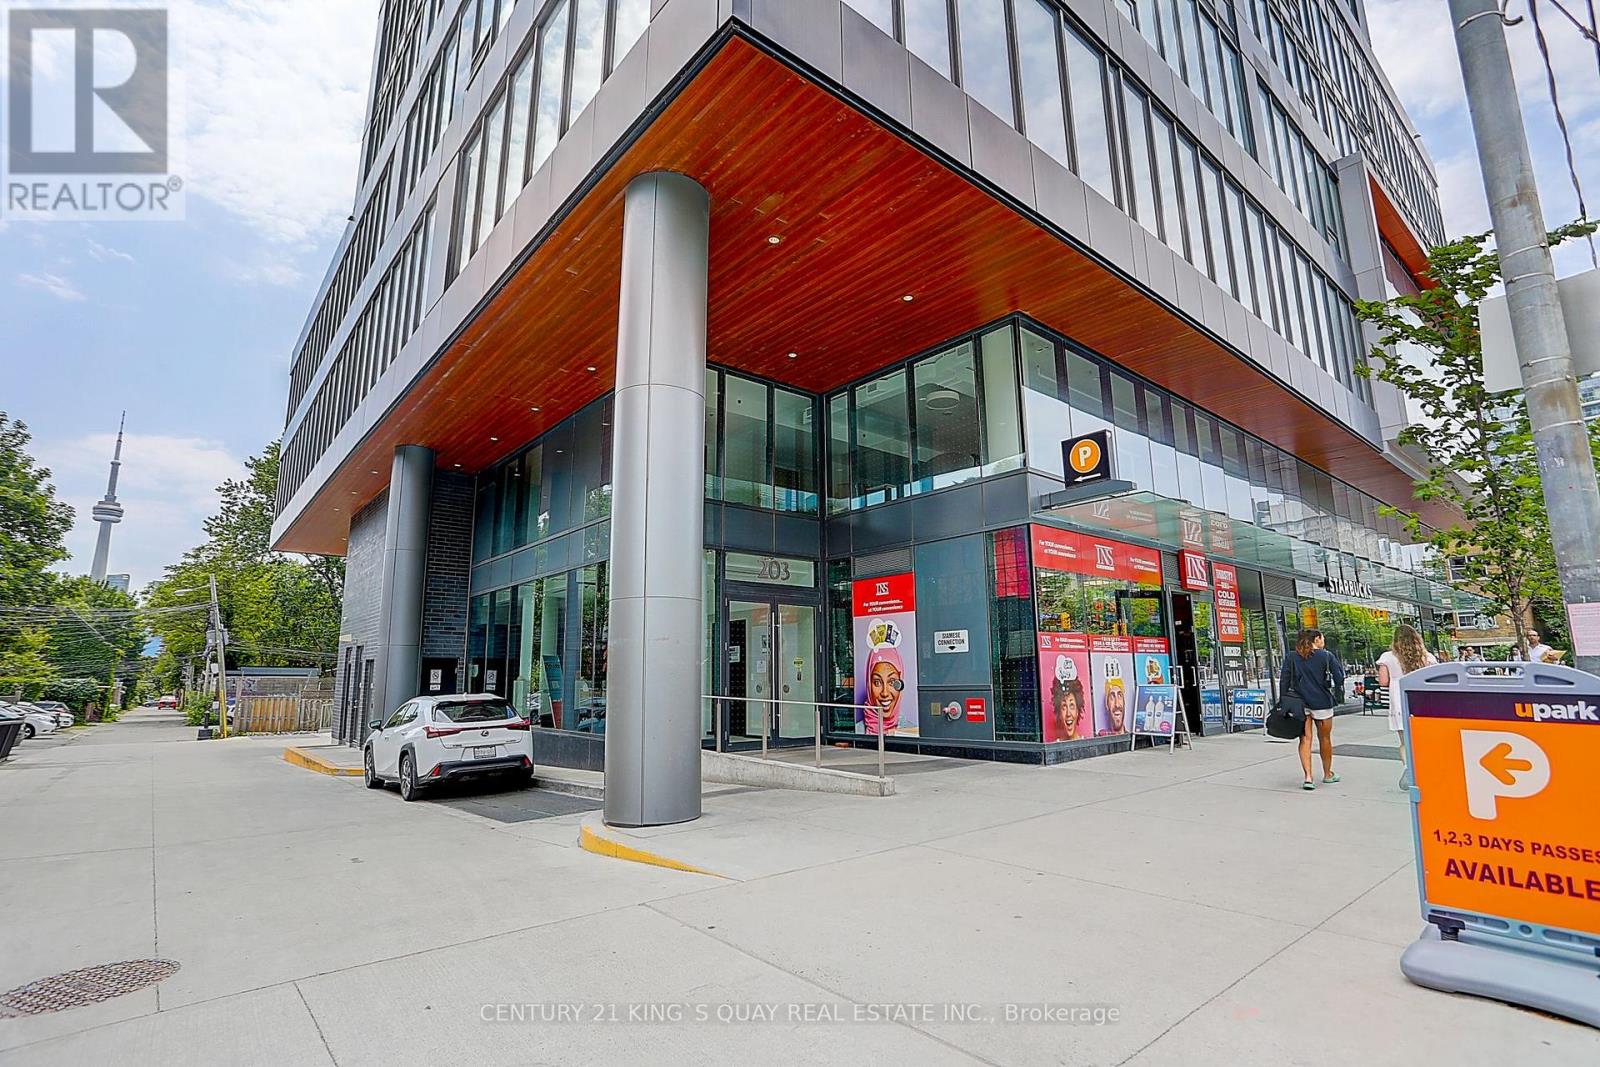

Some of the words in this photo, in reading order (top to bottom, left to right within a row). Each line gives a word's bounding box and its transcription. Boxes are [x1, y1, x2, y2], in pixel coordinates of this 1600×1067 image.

[1079, 446, 1092, 467] P
[758, 560, 790, 580] 203
[1185, 557, 1207, 581] INS
[1217, 590, 1235, 599] COLD
[1329, 576, 1372, 599] STARBUCKS
[1515, 701, 1599, 722] upark
[1460, 729, 1551, 820] P
[1433, 829, 1473, 847] 1,2,3
[1478, 835, 1524, 853] DAYS
[1444, 858, 1600, 901] AVAILABLE
